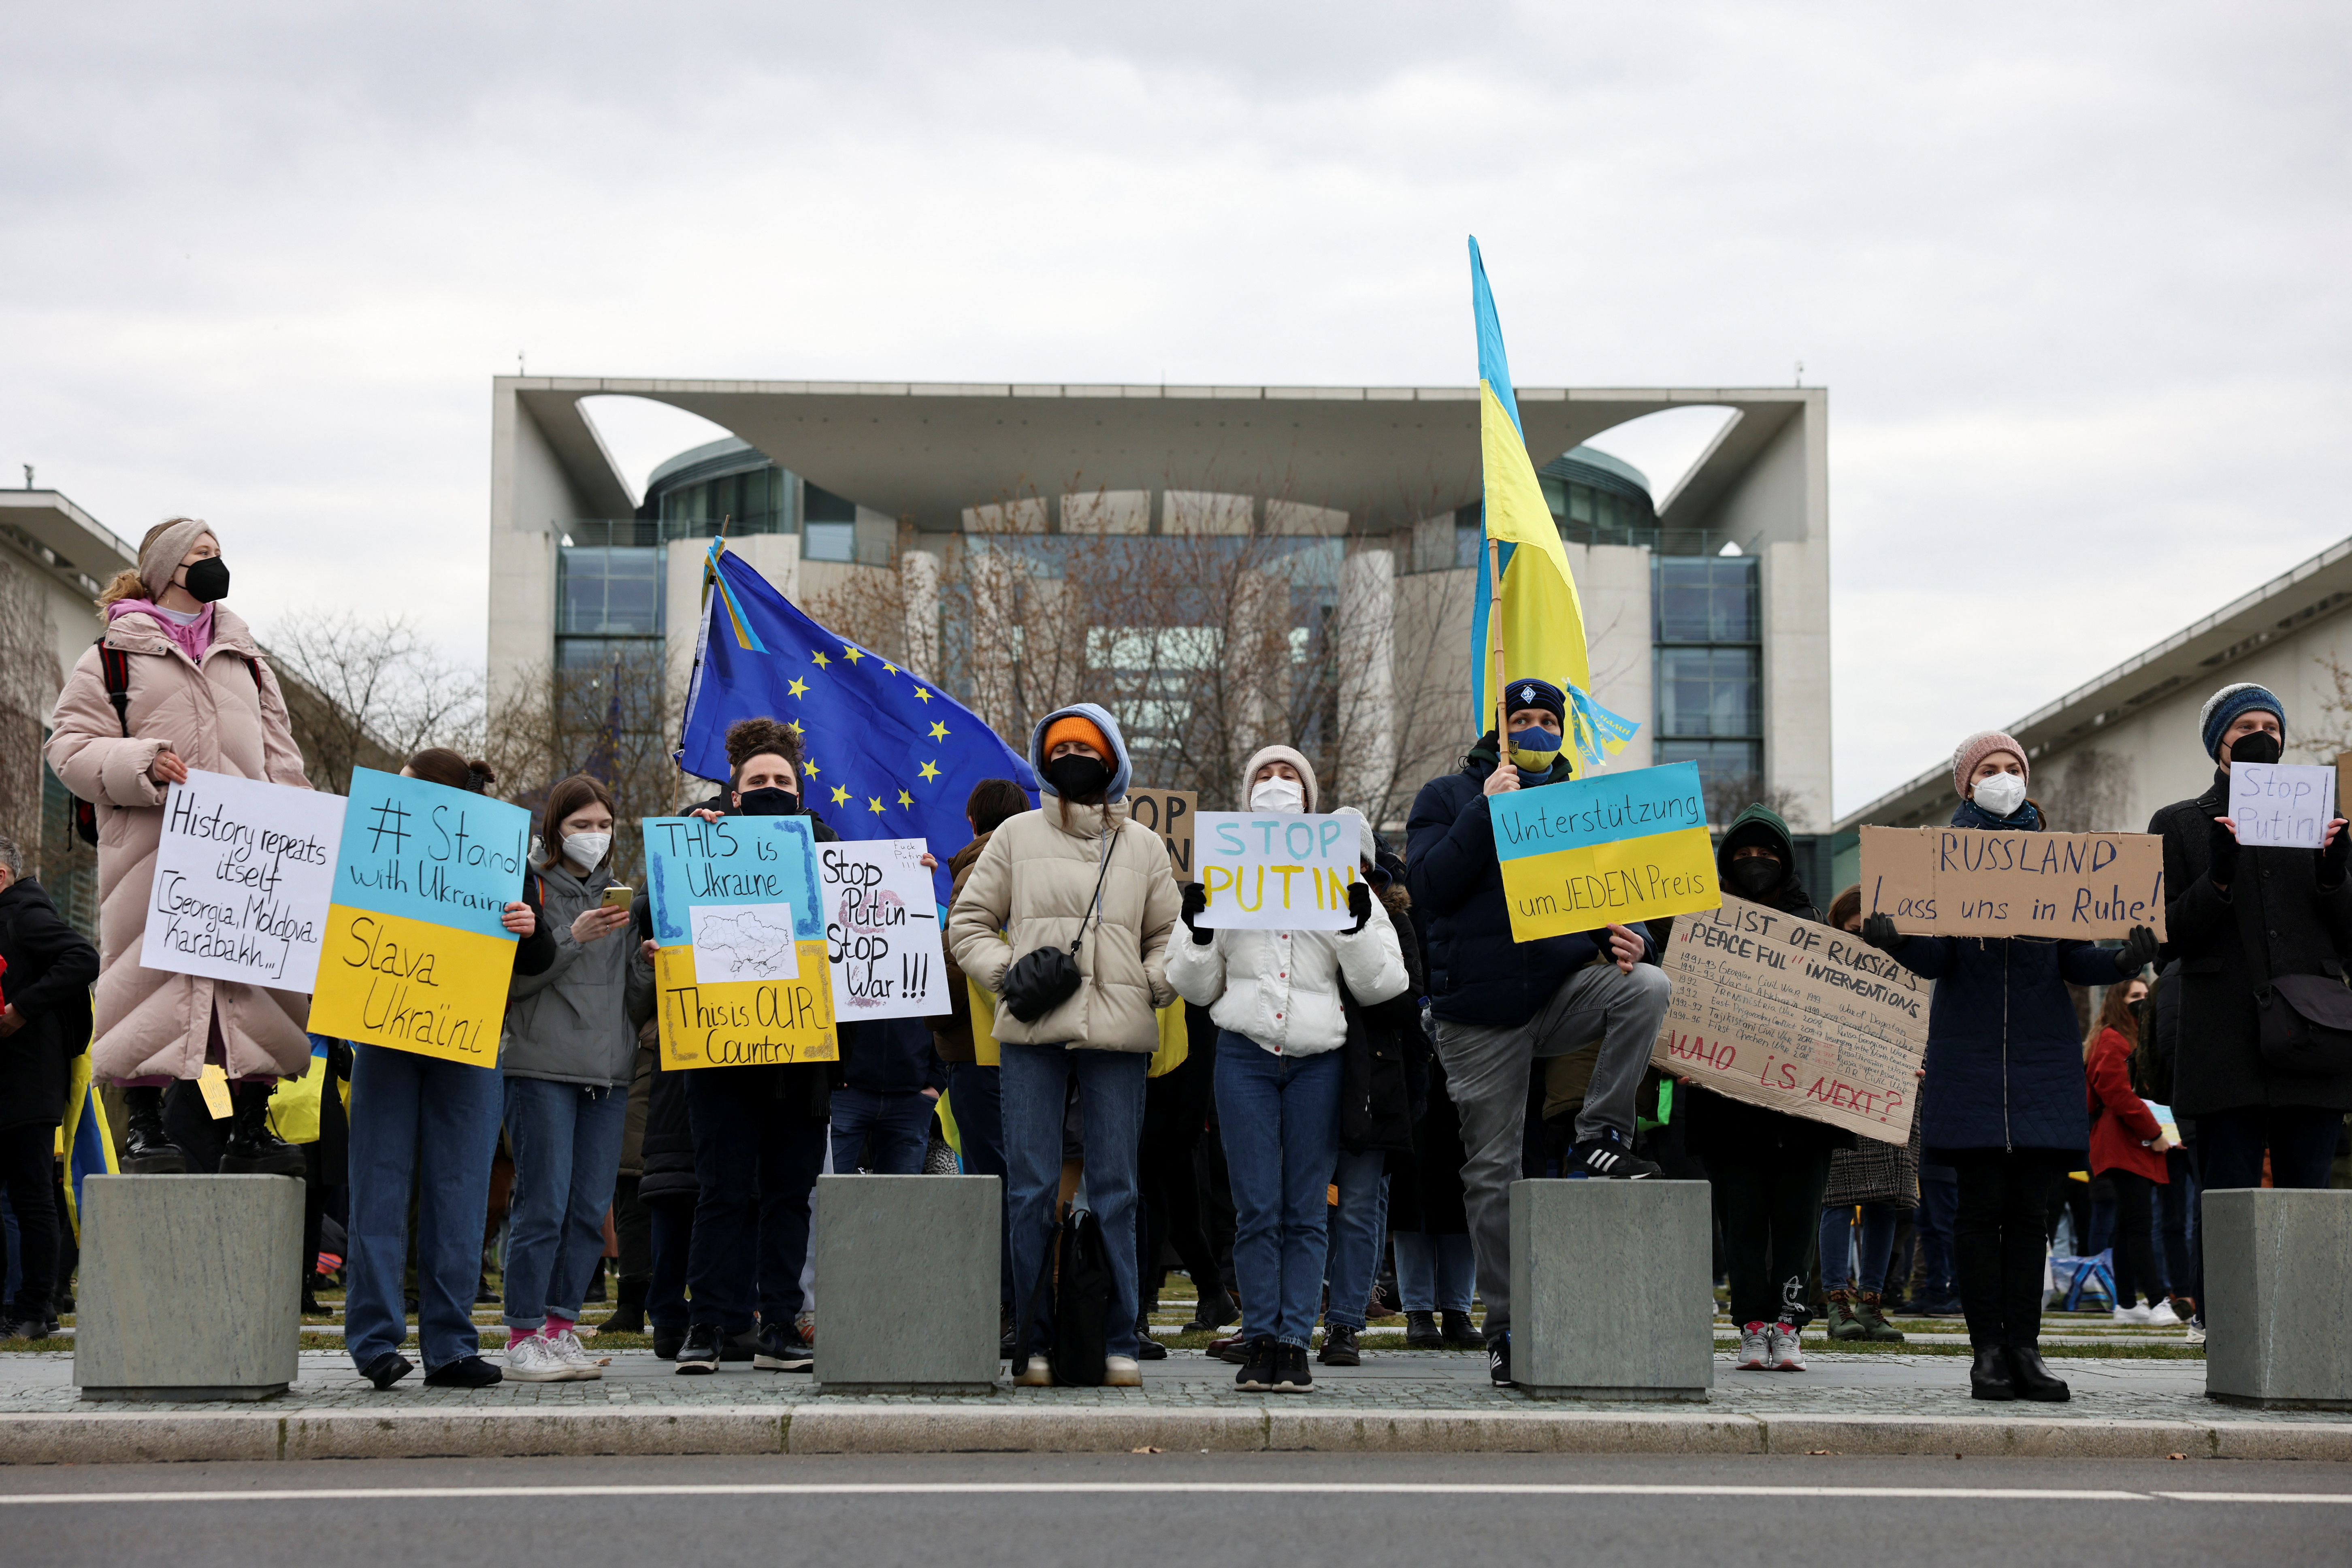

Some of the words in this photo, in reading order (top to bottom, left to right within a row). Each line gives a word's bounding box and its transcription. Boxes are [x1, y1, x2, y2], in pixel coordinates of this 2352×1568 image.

[2239, 768, 2312, 810] Stop
[170, 790, 254, 862] History
[260, 829, 326, 871] repeats
[1127, 795, 1187, 834] OP
[1501, 794, 1699, 845] Unterstützung
[757, 837, 778, 861] is
[894, 840, 916, 850] Fuck
[894, 850, 922, 859] Putin
[1215, 820, 1341, 861] STOP
[1940, 832, 2118, 875] RUSSLAND
[216, 850, 282, 904] itself
[350, 859, 407, 893] with
[686, 863, 783, 897] Ukraine
[822, 849, 882, 895] Stop
[1203, 864, 1355, 912] PUTIN
[1519, 895, 1557, 917] um
[1562, 867, 1644, 912] JEDEN
[1646, 864, 1705, 901] Preis
[243, 894, 317, 943] Moldova
[1873, 875, 1937, 920] Lass
[1962, 899, 2009, 920] uns
[2032, 898, 2056, 921] in
[343, 917, 439, 986] Slava
[827, 923, 888, 981] Stop
[1790, 927, 1822, 951] OF
[846, 961, 894, 998] War
[1679, 975, 1697, 986] 1992
[1807, 992, 1821, 1004] 1999
[666, 987, 727, 1028] This
[730, 1001, 749, 1027] is
[756, 986, 829, 1029] OUR
[1669, 1009, 1701, 1023] 1994-96
[1672, 997, 1702, 1012] 1992-97
[1803, 1015, 1823, 1028] 2008
[706, 1029, 795, 1064] Country
[1669, 1029, 1736, 1071] WHO
